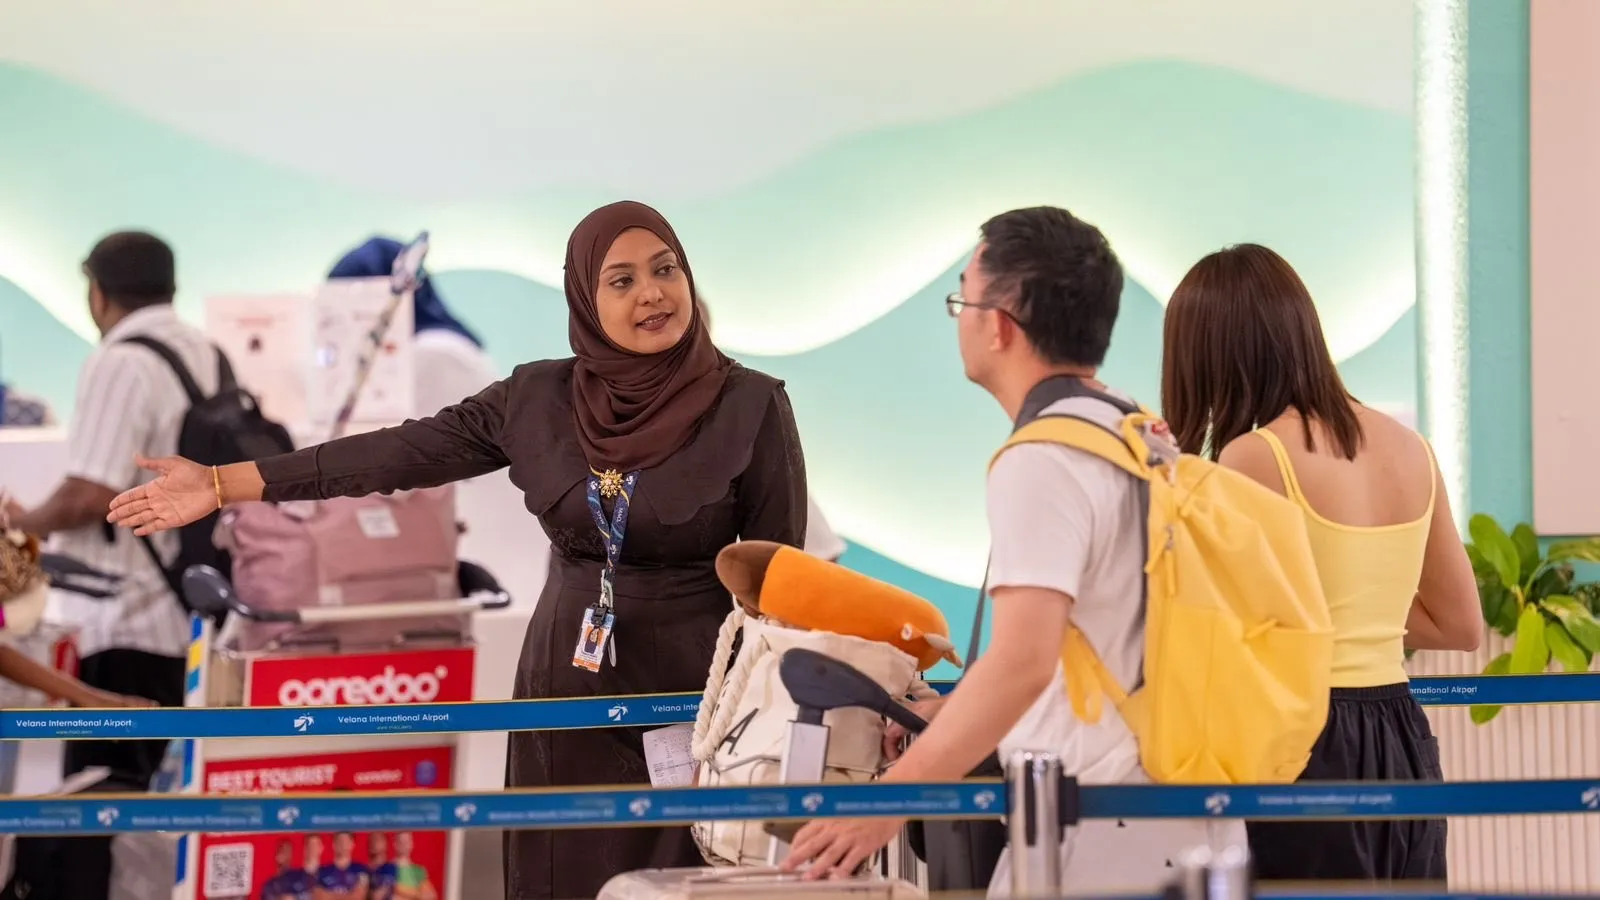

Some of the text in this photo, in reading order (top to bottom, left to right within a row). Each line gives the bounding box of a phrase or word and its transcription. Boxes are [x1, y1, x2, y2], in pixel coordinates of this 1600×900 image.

[279, 665, 446, 706] ooredoo
[1451, 686, 1478, 695] Airport
[651, 704, 681, 712] Velana
[16, 718, 132, 728] Velana International Airport
[338, 713, 449, 724] Velana International Airport
